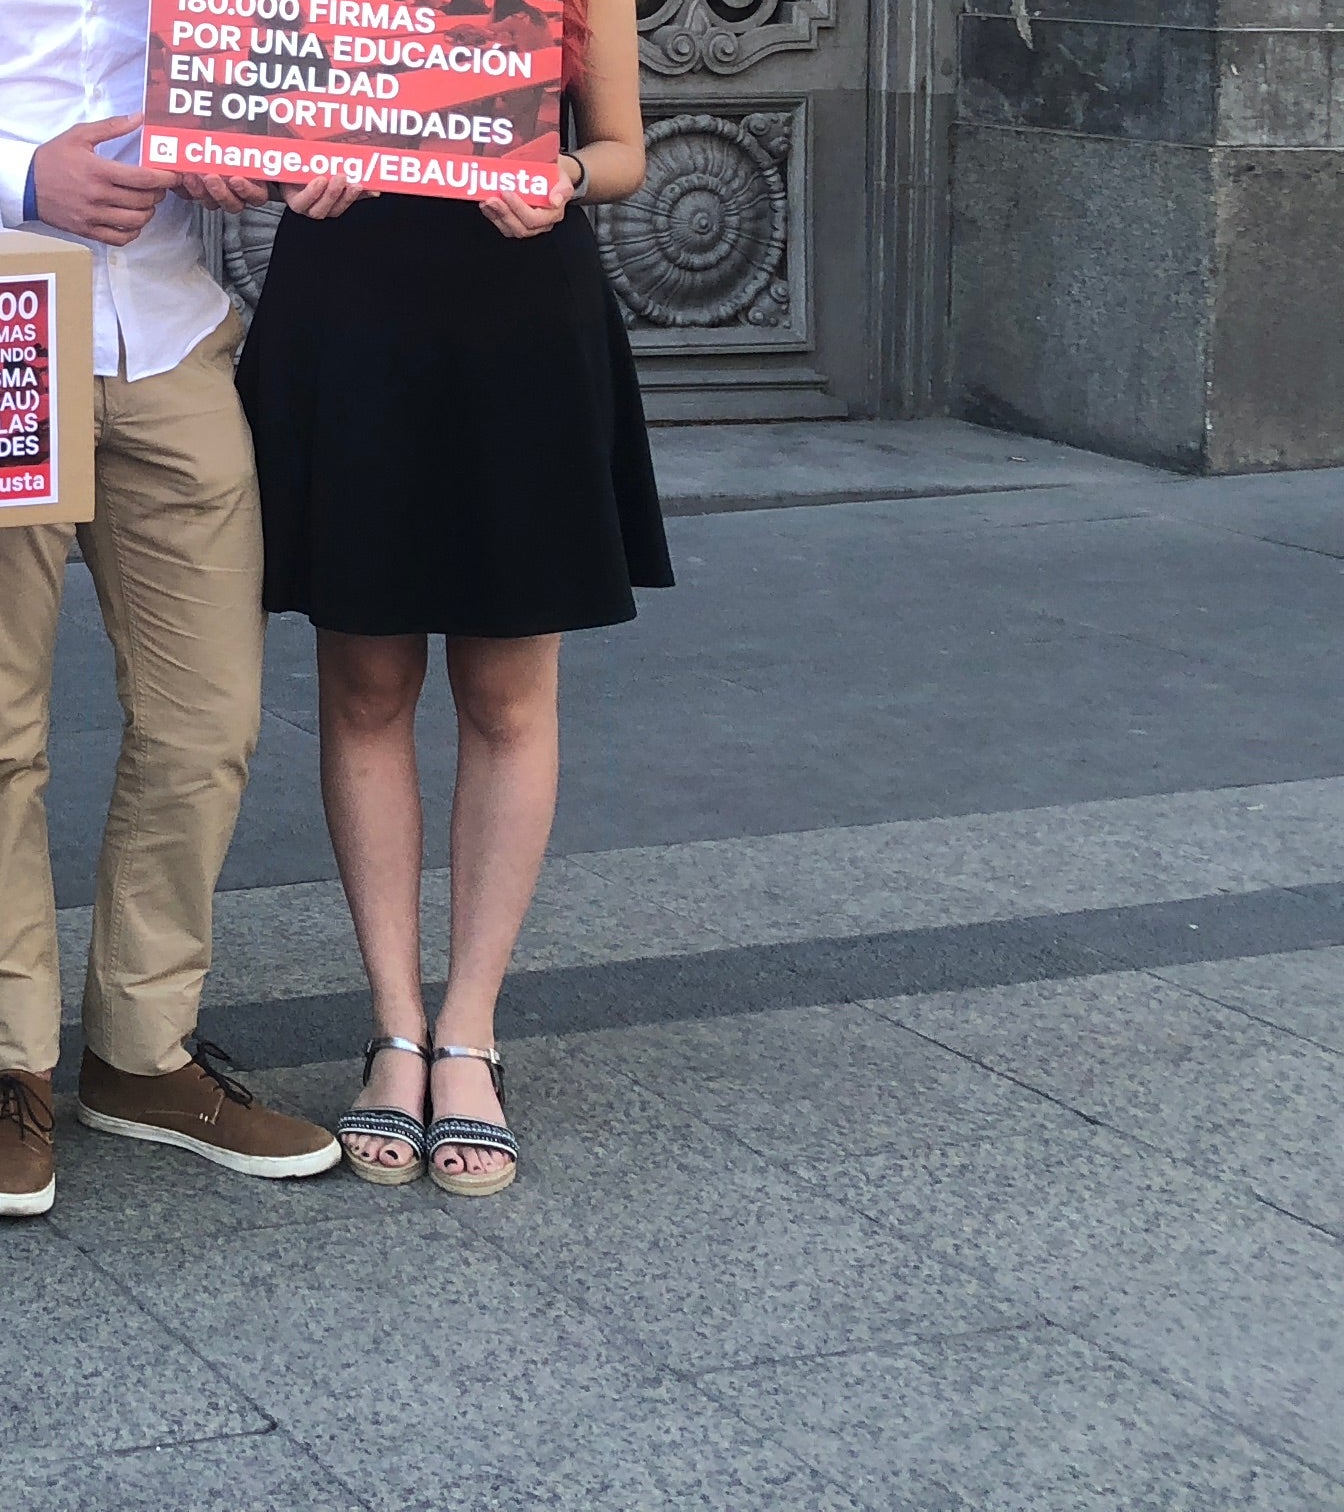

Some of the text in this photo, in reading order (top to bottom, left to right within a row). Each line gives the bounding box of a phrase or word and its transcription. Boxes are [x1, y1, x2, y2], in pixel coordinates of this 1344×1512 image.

[170, 54, 400, 100] EN IGUALDAD
[172, 21, 533, 78] POR UNA EDUCACIÓN
[168, 88, 514, 146] DE OPORTUNIDADES
[184, 137, 549, 196] change.org/EBAUjusta
